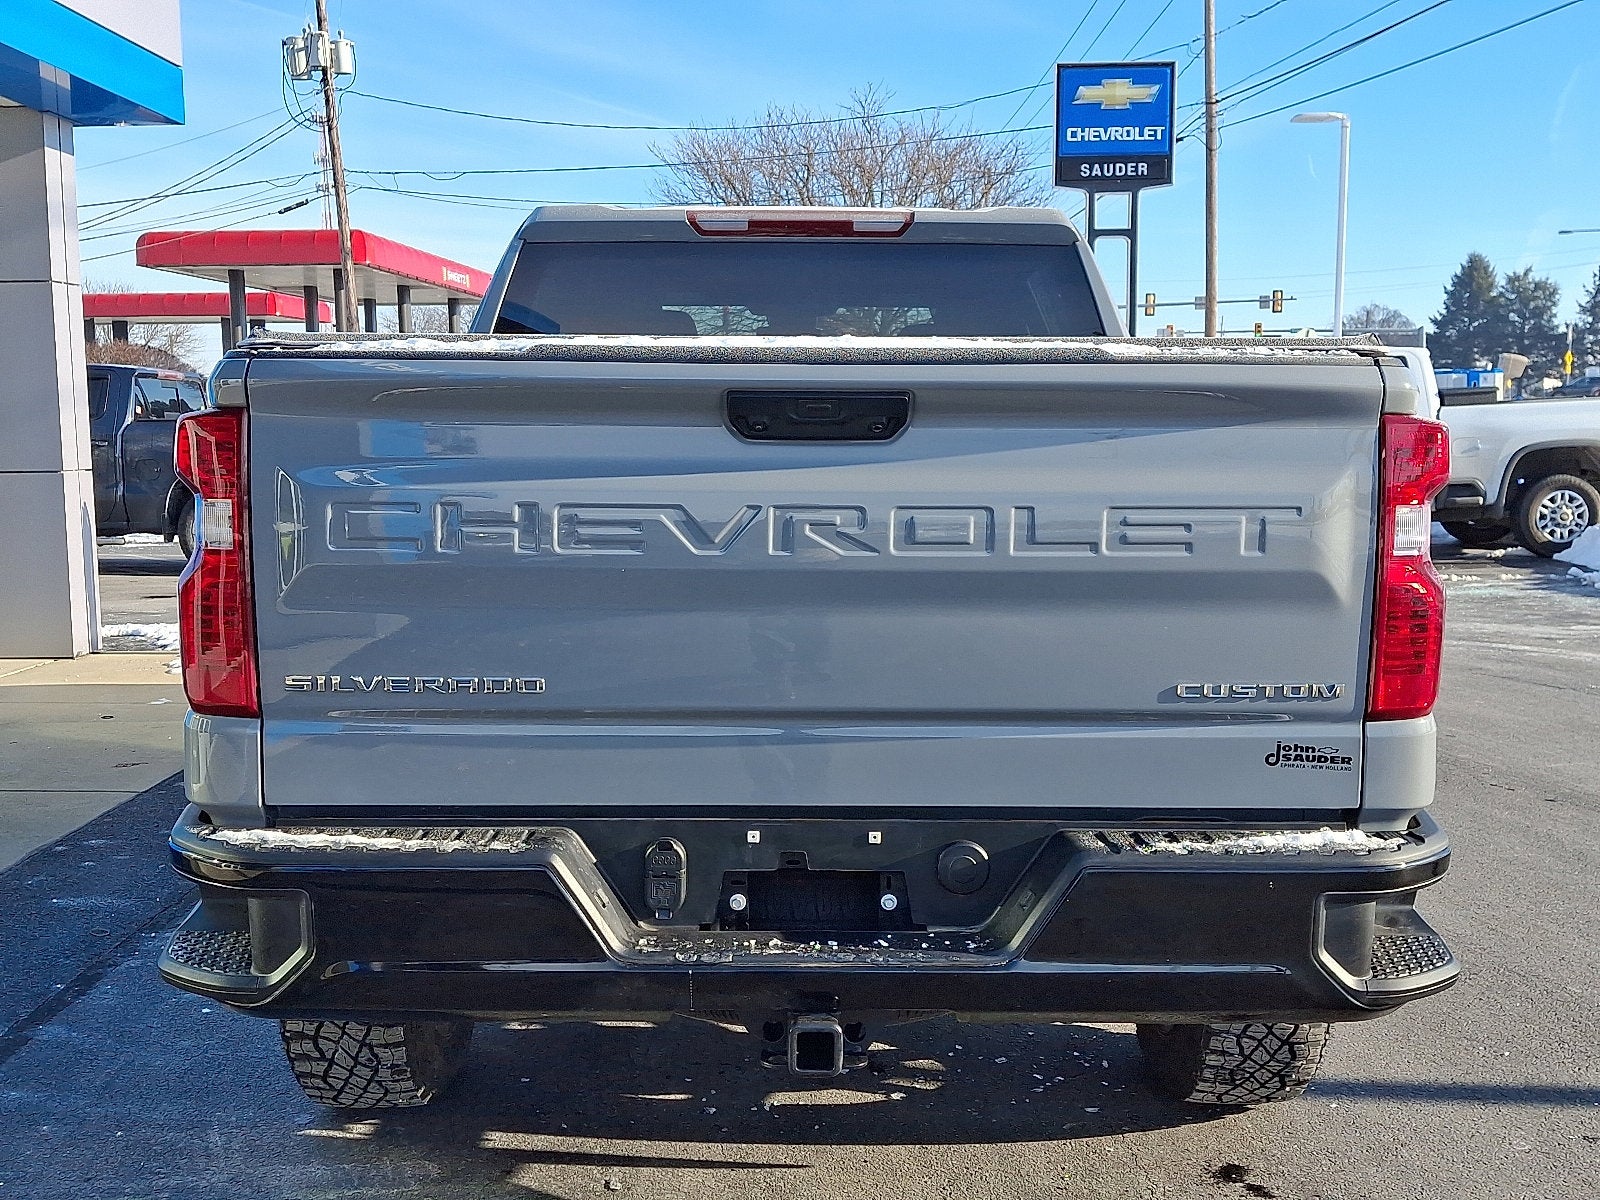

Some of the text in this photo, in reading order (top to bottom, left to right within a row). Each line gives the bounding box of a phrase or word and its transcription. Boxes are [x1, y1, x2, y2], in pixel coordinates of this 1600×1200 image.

[1066, 126, 1165, 142] CHEVROLET
[1080, 162, 1148, 177] SAUDER
[326, 502, 1303, 557] CHEVROLET
[284, 675, 546, 694] SILVERADO
[1176, 683, 1345, 699] CUSTOM
[1281, 753, 1353, 766] SAUDER
